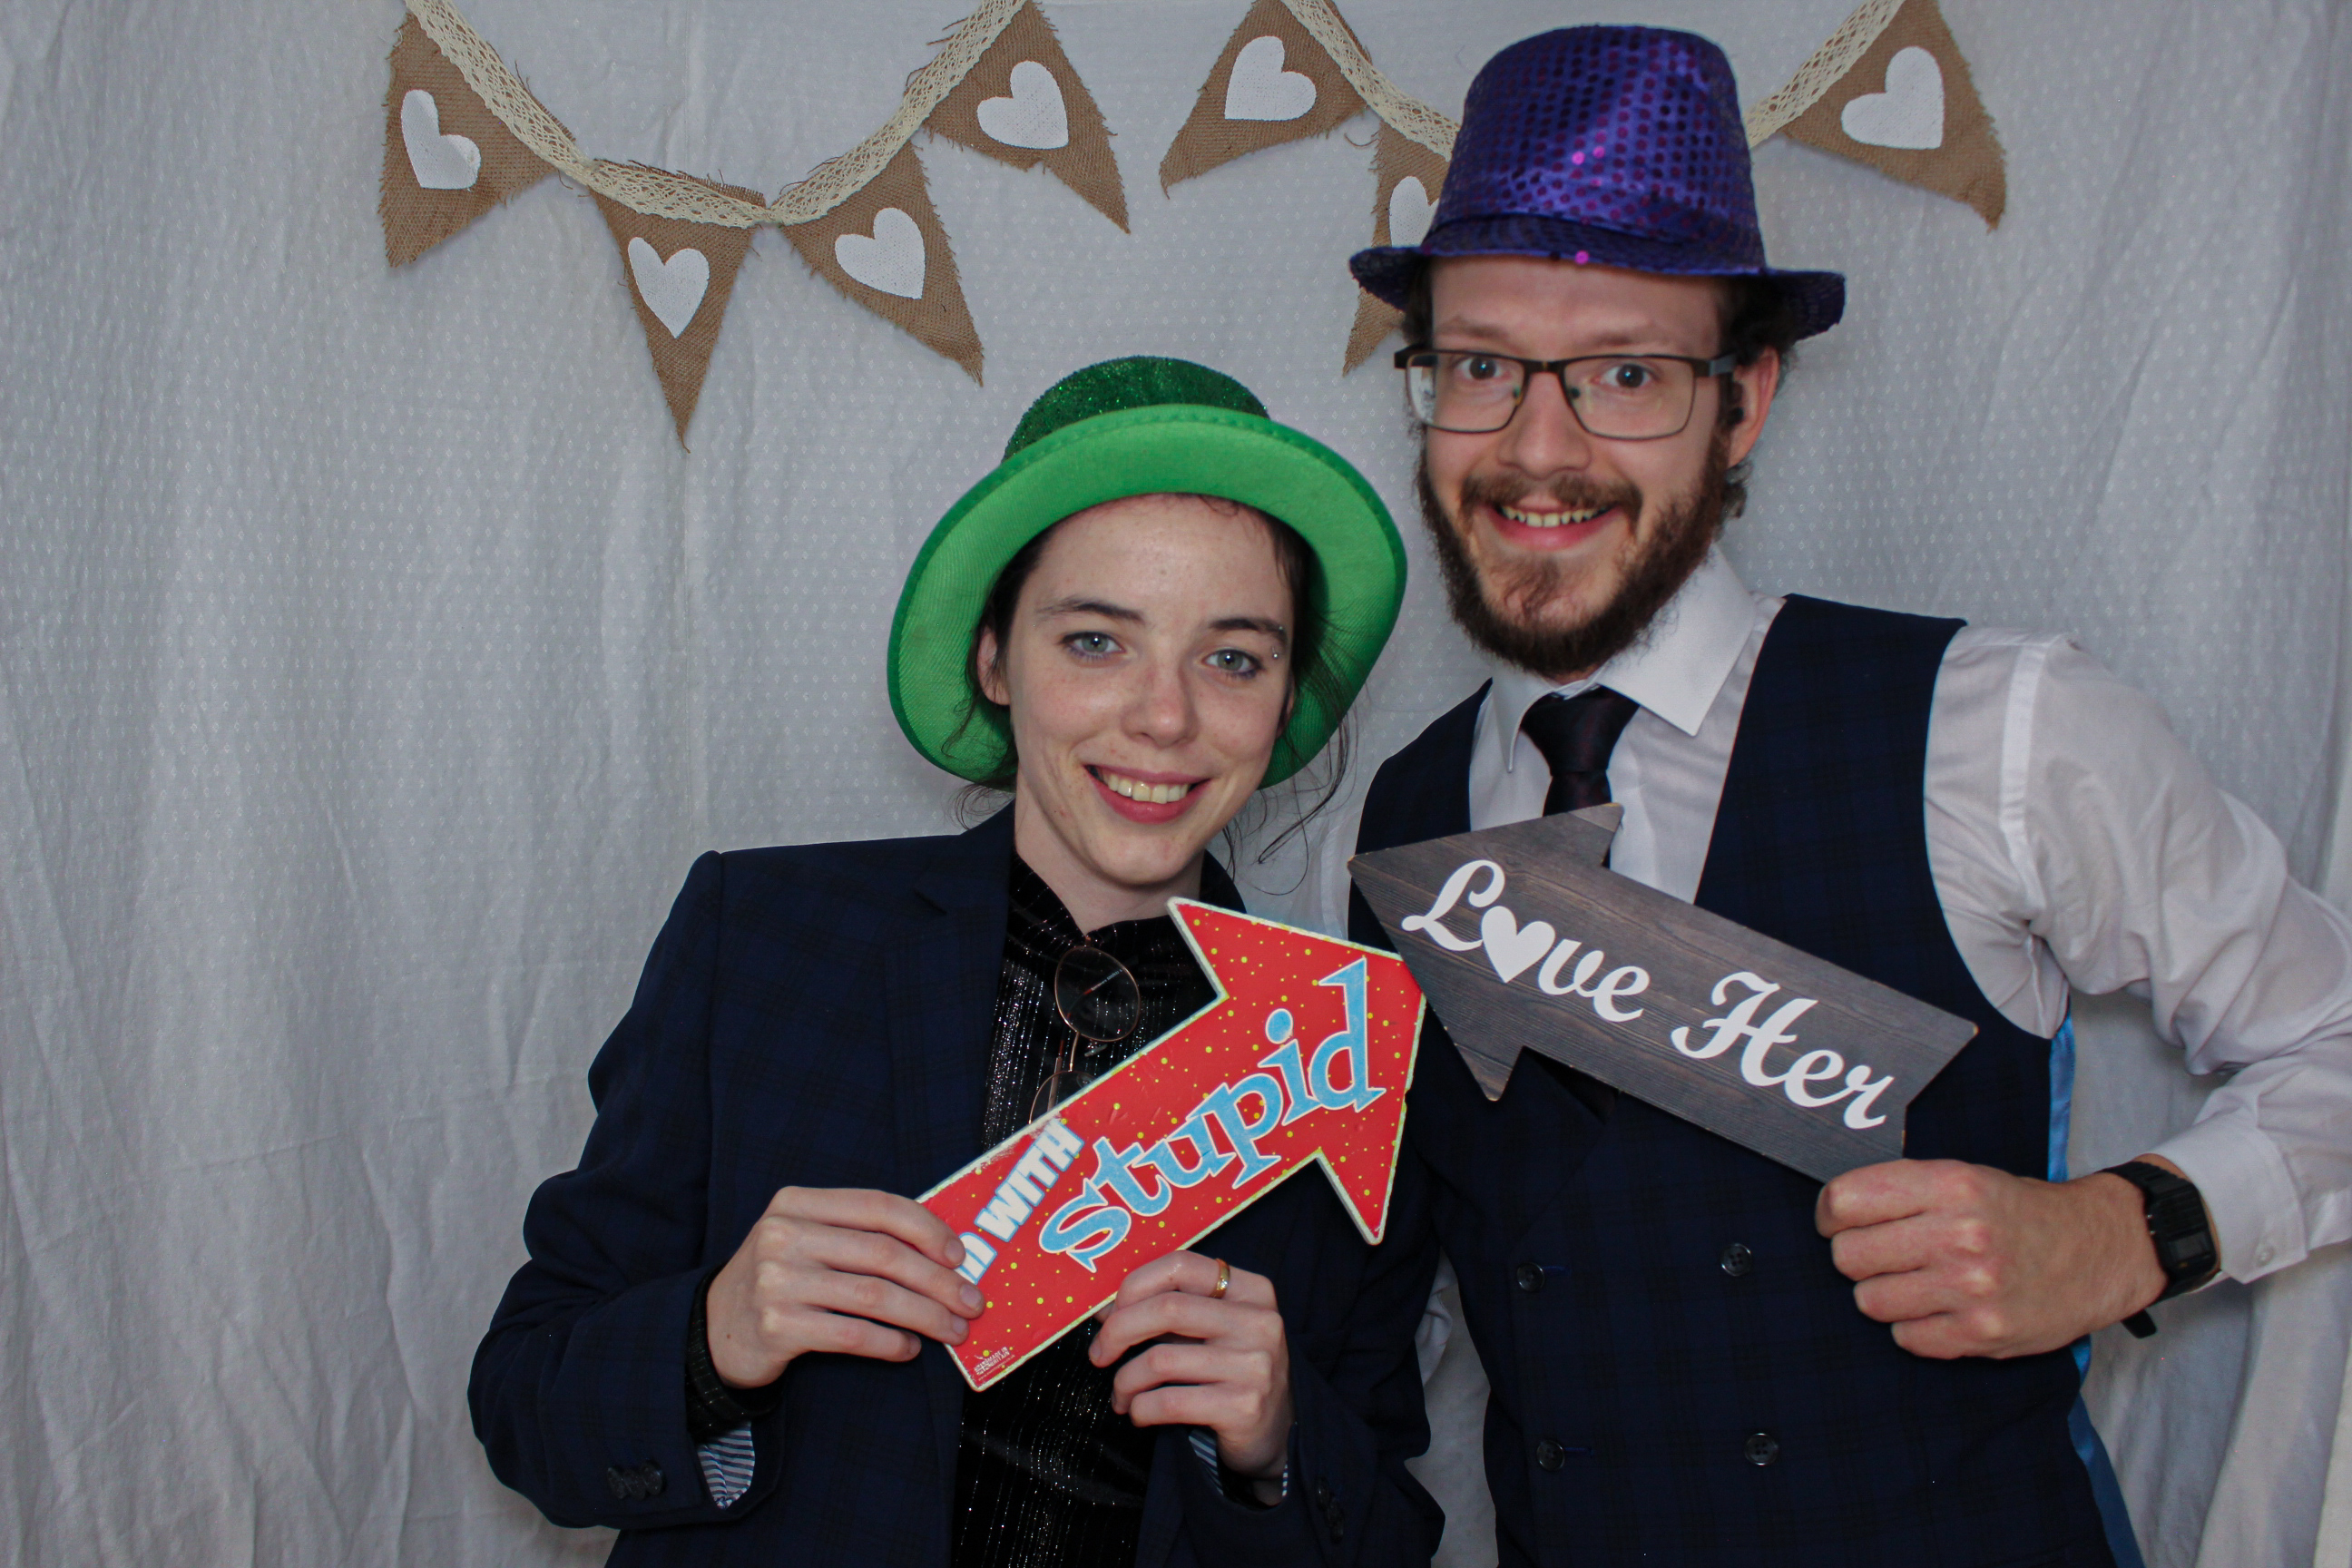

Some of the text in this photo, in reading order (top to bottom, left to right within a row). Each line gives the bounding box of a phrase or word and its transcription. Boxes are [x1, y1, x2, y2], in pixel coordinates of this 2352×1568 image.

[1038, 957, 1387, 1273] stupid
[1670, 971, 1895, 1130] Her
[974, 1118, 1084, 1242] WITH
